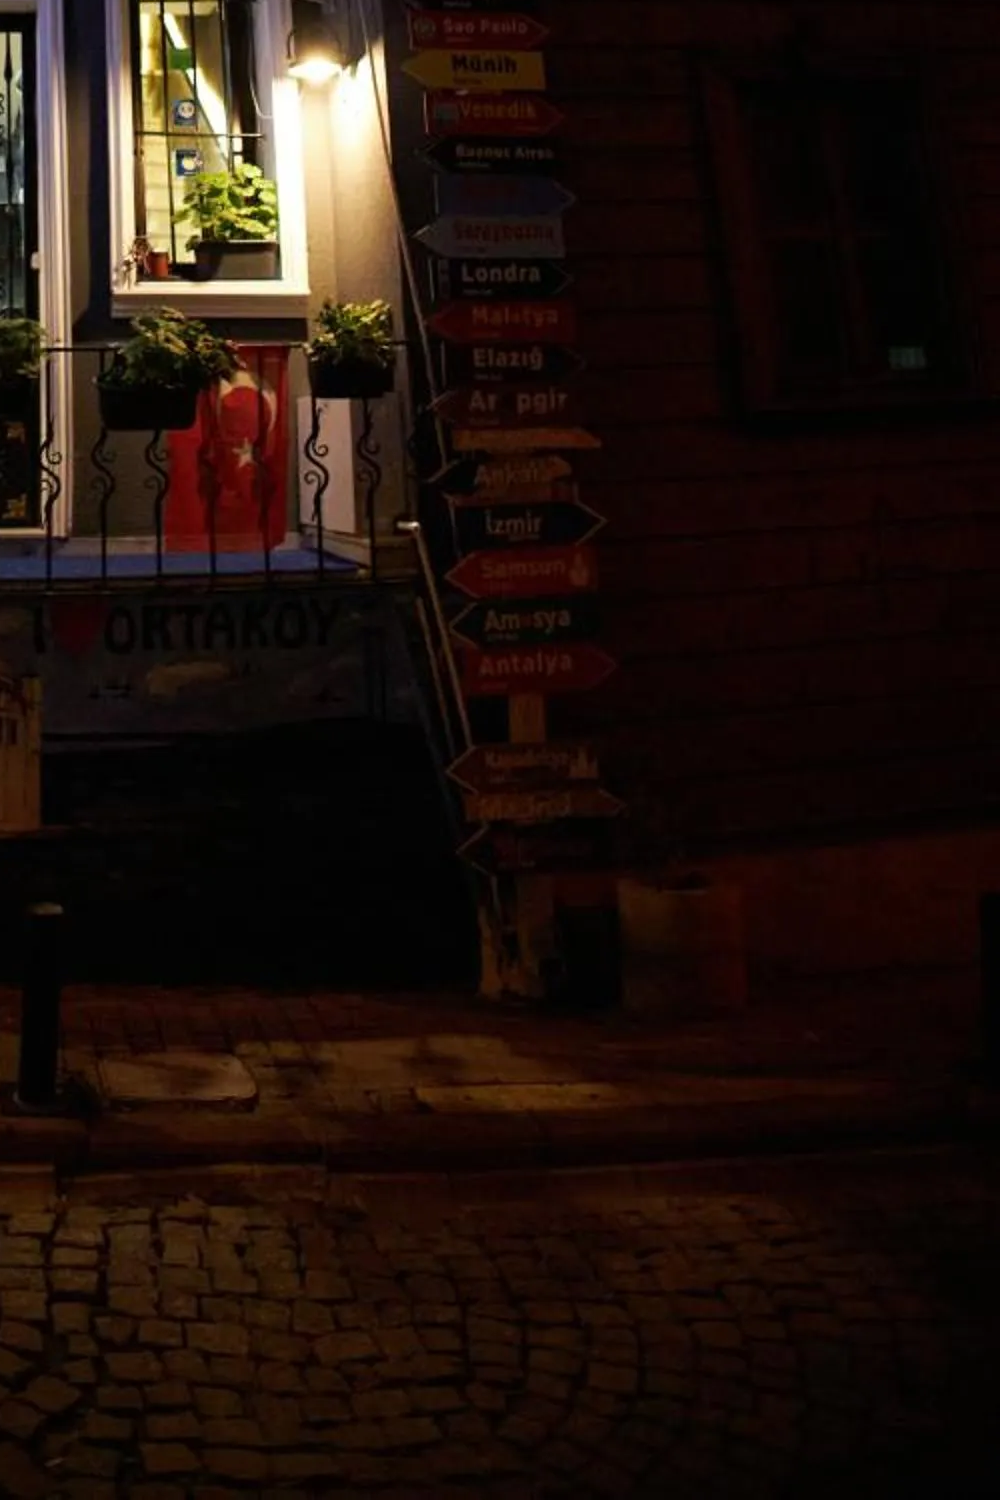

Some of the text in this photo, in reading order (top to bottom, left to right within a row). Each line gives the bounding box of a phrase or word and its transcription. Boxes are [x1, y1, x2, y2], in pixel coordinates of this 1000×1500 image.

[452, 52, 518, 75] Münih
[460, 261, 543, 285] Londra
[467, 386, 570, 417] Arpgir
[479, 556, 567, 579] Samsun
[478, 647, 575, 678] Antalya
